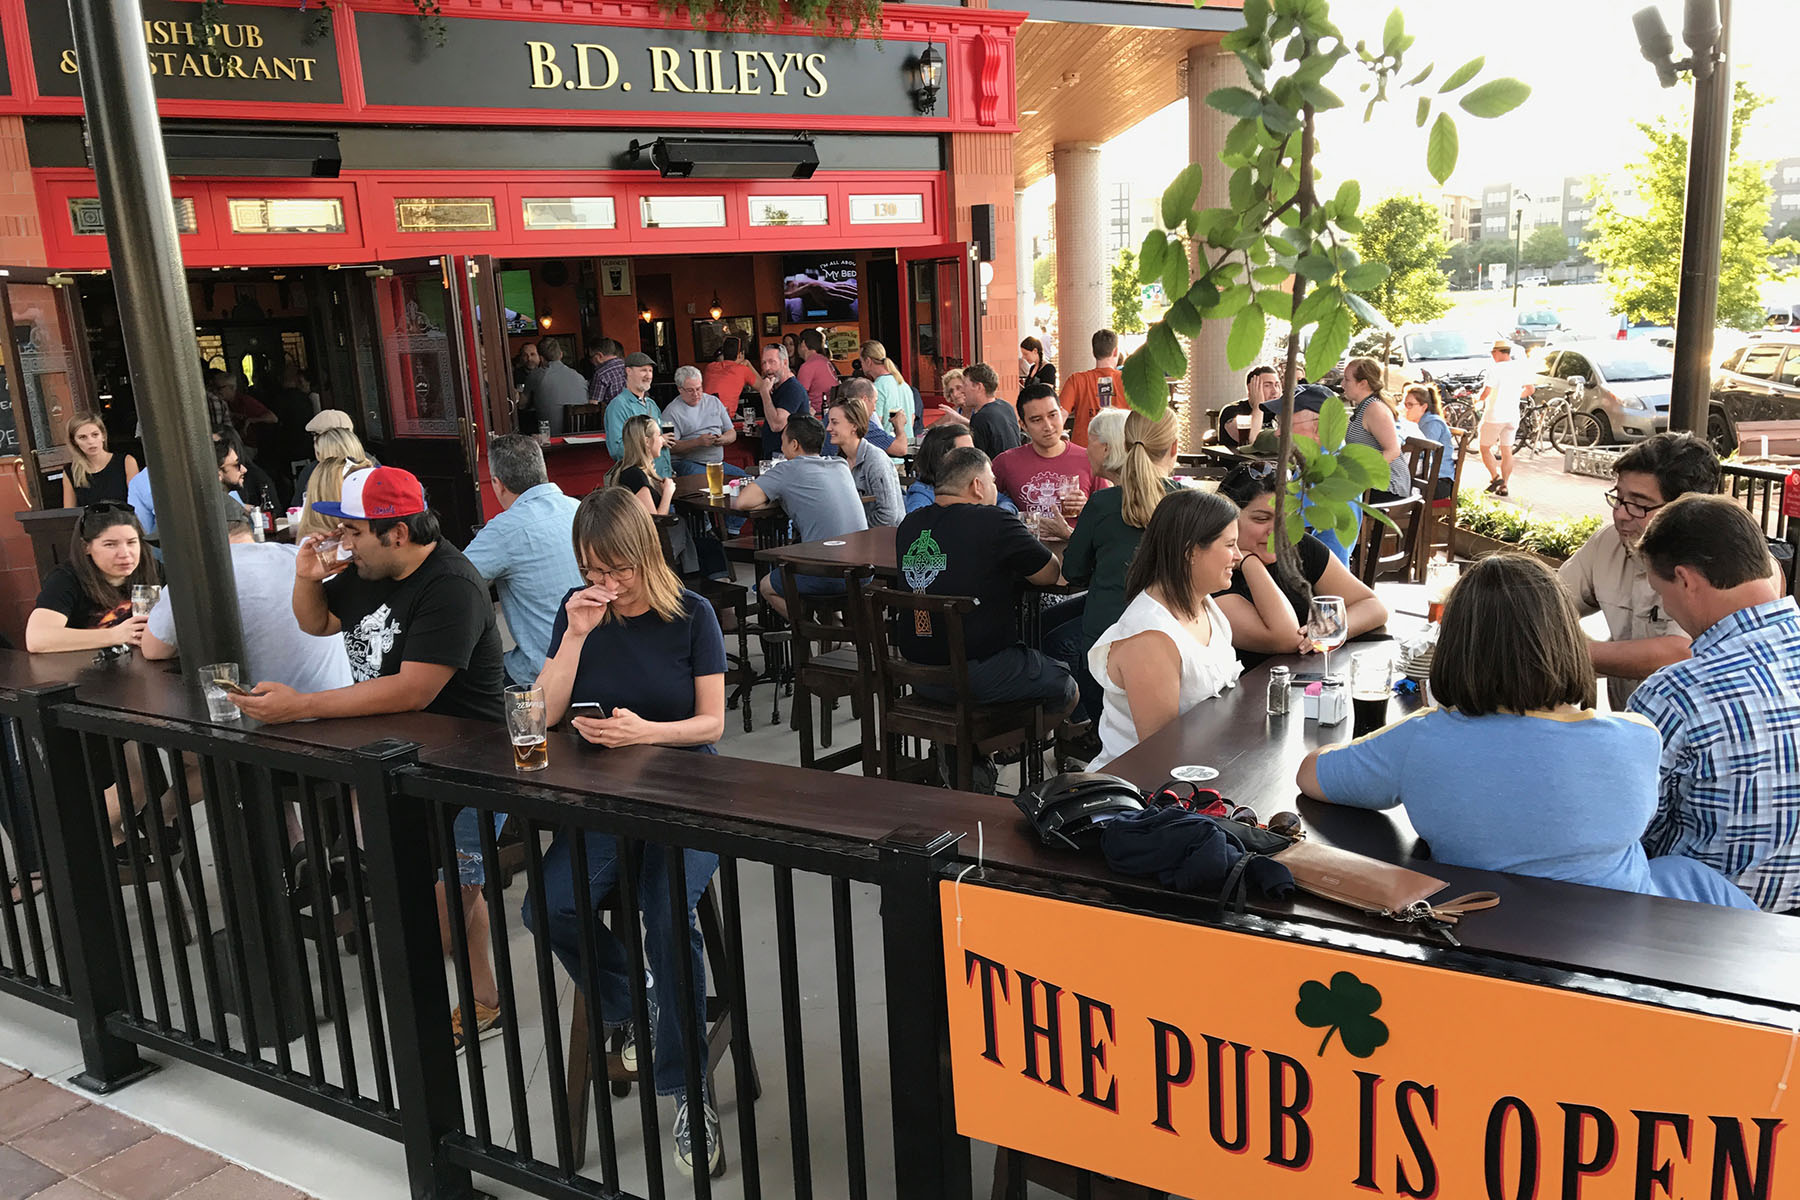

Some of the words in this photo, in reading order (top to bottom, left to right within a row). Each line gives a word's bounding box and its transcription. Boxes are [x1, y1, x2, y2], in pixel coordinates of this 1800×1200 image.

[145, 20, 195, 46] ISH
[206, 24, 264, 48] PUB
[59, 49, 79, 75] &
[149, 52, 316, 82] STAURANT
[526, 40, 632, 91] B.D.
[648, 46, 829, 98] RILEY'S
[873, 202, 898, 217] 130
[841, 270, 857, 278] BED
[964, 948, 1119, 1115] THE
[1146, 1016, 1313, 1172] PUB
[1351, 1069, 1440, 1200] IS
[1484, 1095, 1788, 1200] OPEN
